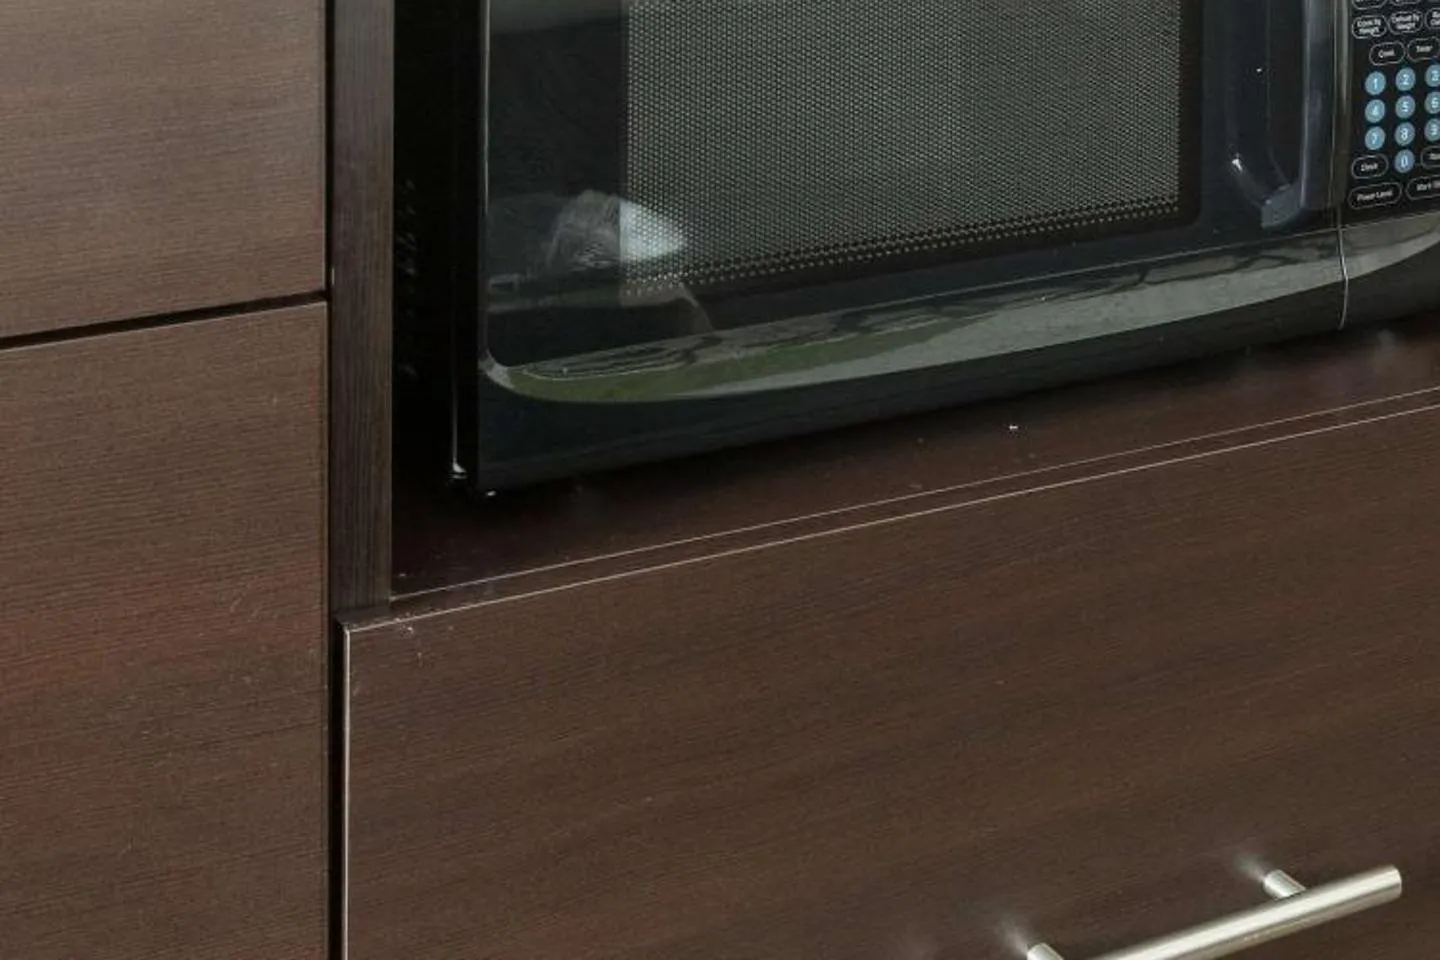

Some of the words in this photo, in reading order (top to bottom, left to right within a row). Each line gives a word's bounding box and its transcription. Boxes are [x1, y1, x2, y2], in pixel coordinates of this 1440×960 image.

[1403, 74, 1410, 85] 2
[1403, 102, 1409, 113] 5
[1402, 128, 1409, 140] 8
[1401, 156, 1408, 167] 0
